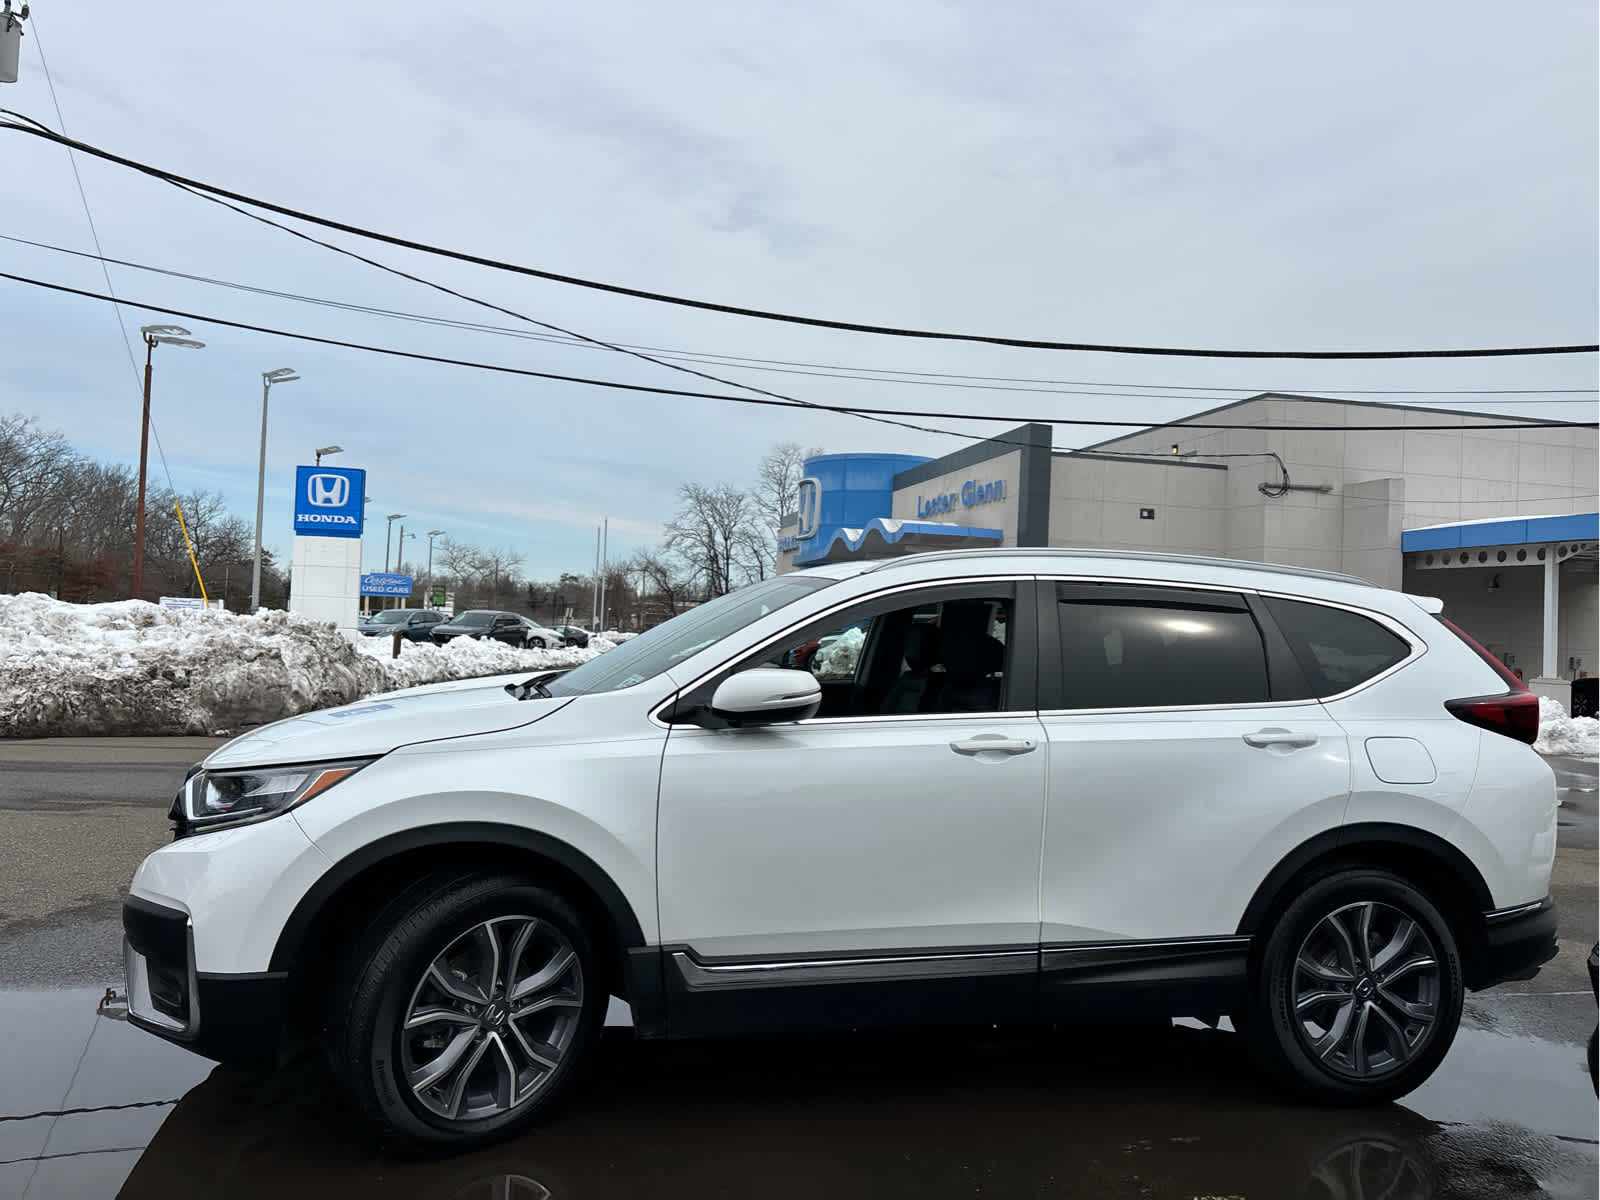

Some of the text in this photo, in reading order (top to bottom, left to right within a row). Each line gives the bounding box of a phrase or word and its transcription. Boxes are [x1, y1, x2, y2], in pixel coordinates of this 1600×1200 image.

[917, 480, 1003, 518] Lester Glenn
[297, 514, 357, 524] HONDA
